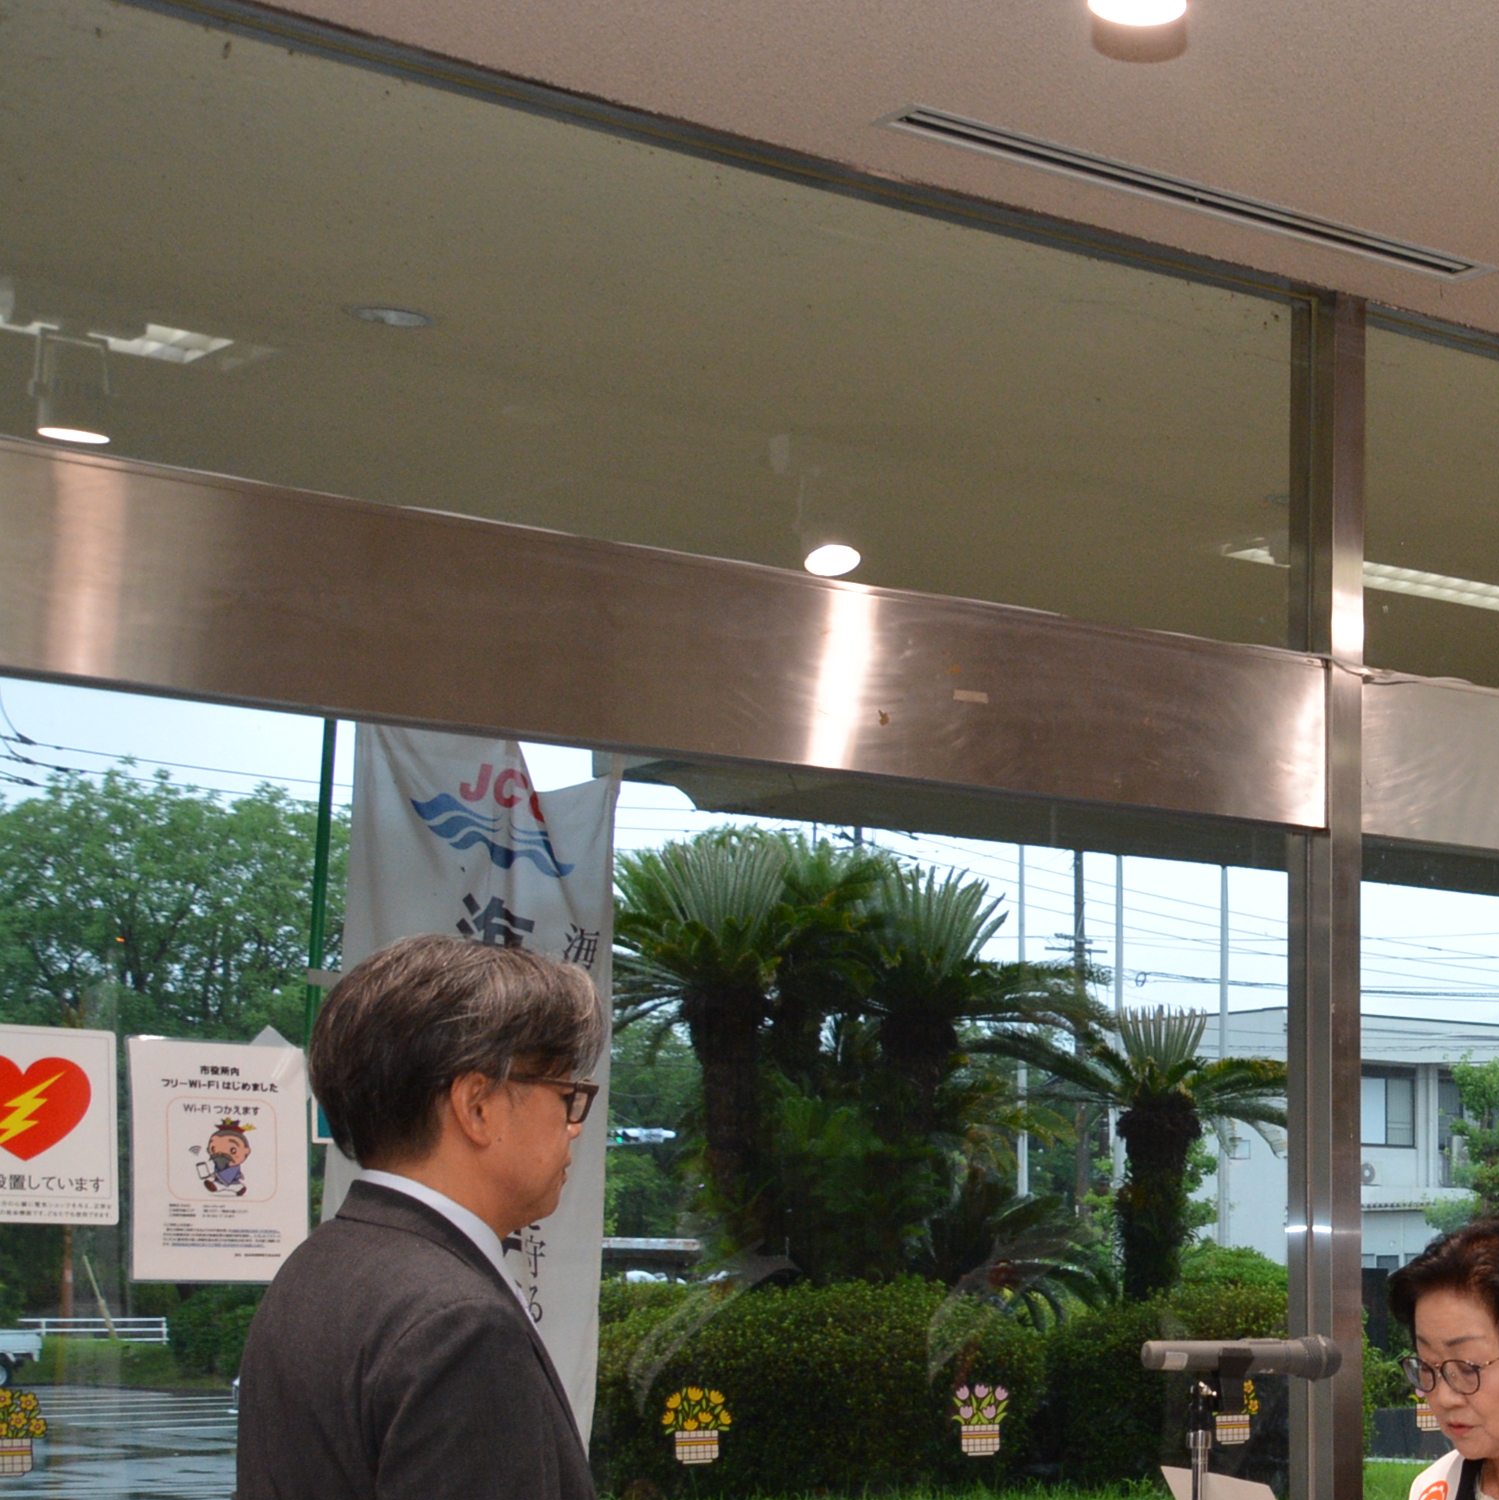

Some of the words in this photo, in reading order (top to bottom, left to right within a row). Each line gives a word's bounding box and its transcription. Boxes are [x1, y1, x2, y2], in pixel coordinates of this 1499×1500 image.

[459, 763, 545, 823] JC
[200, 1065, 240, 1077] 市役所内
